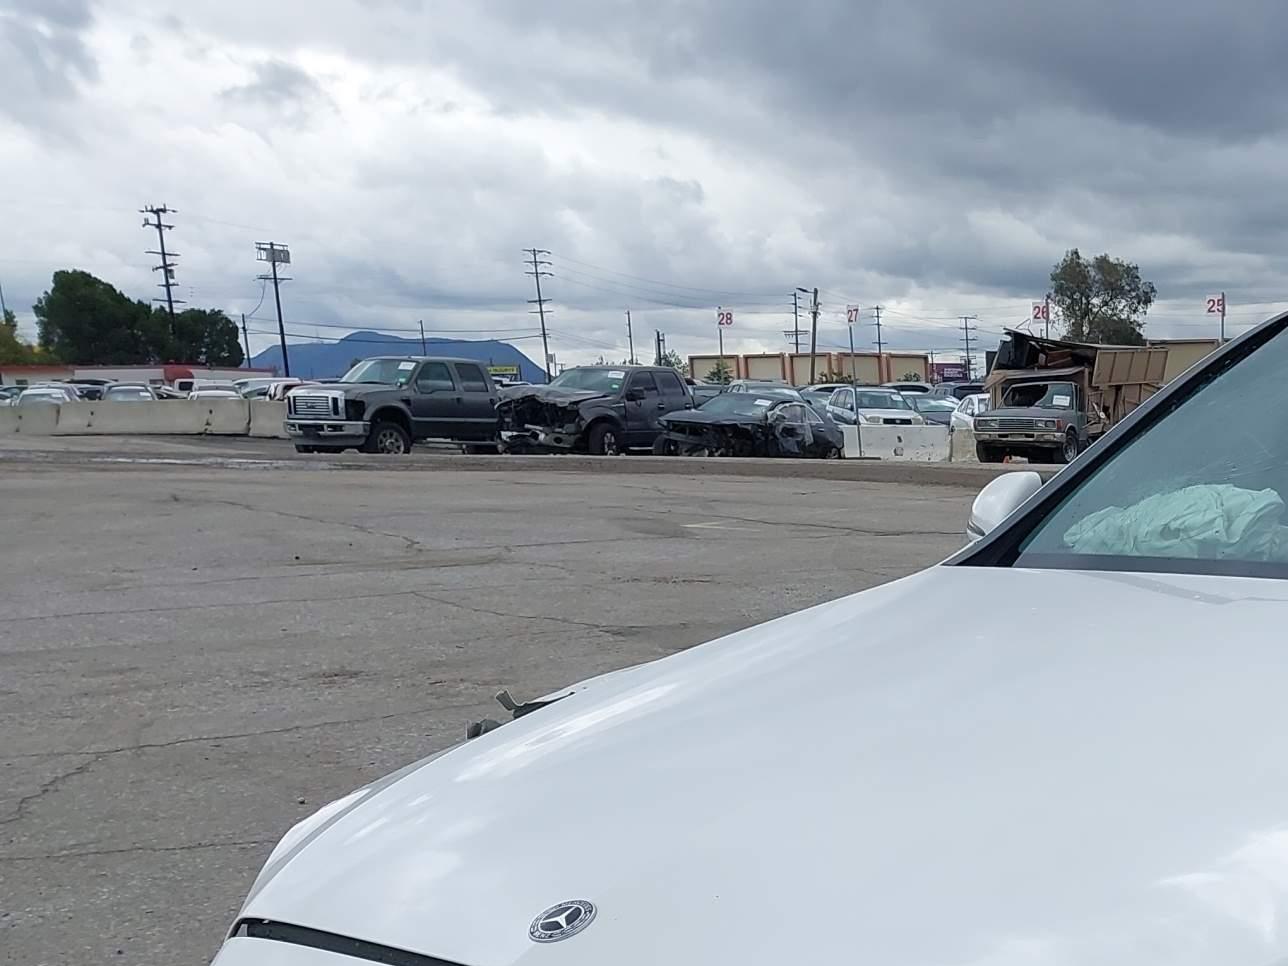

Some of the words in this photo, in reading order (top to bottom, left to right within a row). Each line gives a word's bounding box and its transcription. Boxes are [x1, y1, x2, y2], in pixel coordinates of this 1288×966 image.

[1033, 305, 1049, 320] 26
[1207, 299, 1225, 313] 25
[718, 312, 733, 325] 28
[847, 308, 859, 322] 27
